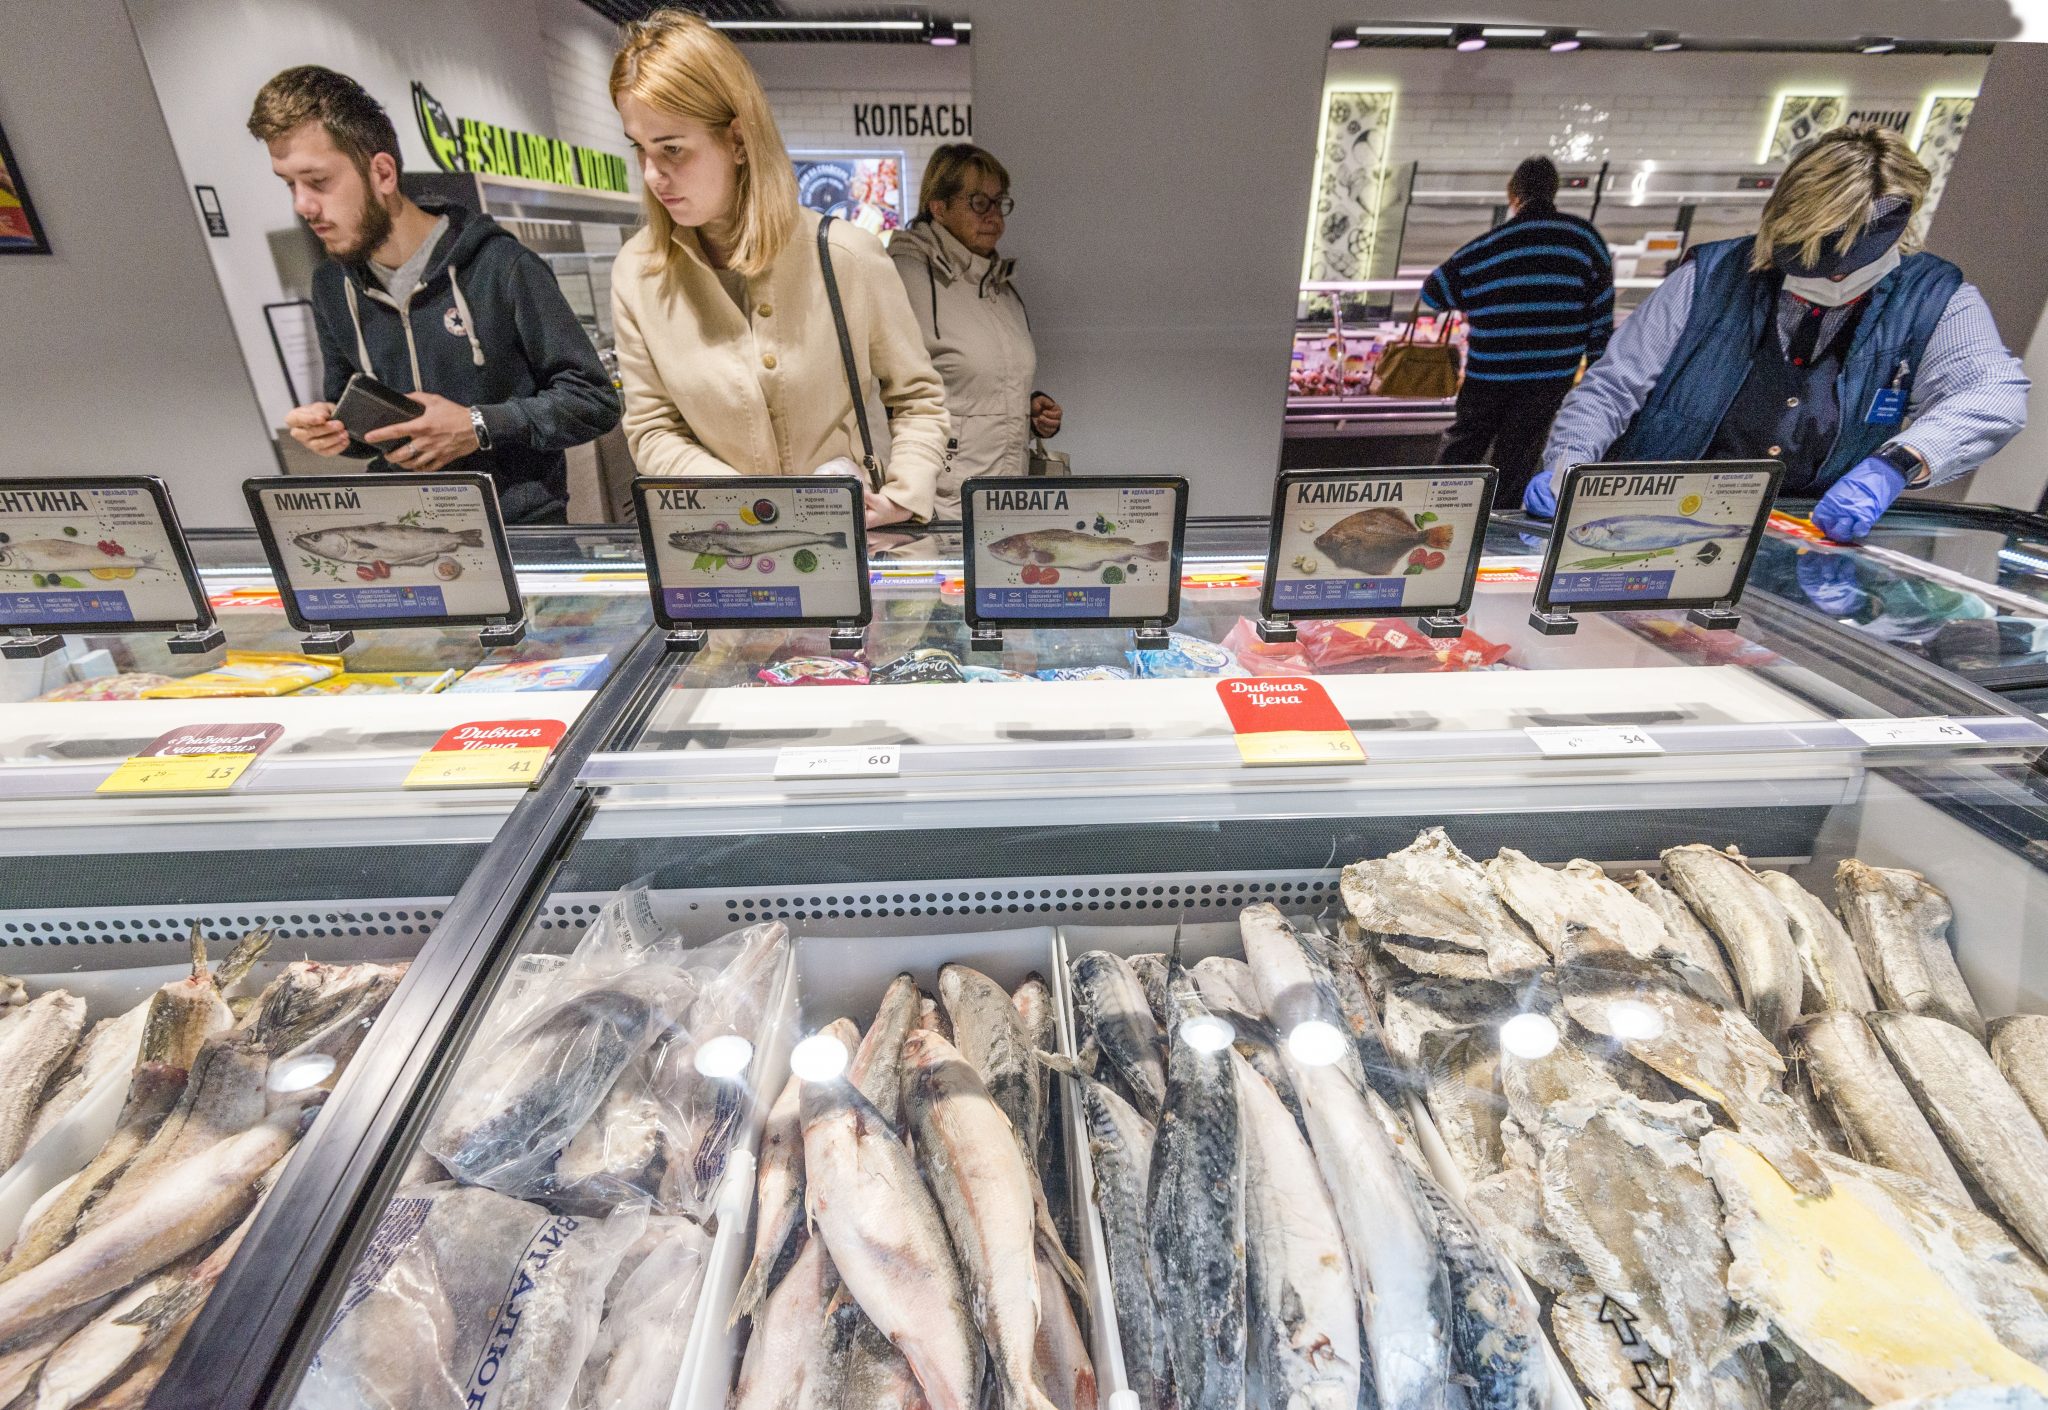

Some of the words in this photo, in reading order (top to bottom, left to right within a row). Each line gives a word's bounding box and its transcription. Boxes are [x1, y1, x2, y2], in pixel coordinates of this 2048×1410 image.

[854, 104, 972, 137] КОЛБАСЫ
[1579, 475, 1684, 496] МЕРЛАНГ
[1297, 482, 1403, 503] КАМБАЛА
[274, 488, 361, 511] МИНТАЙ
[986, 490, 1069, 511] НАВАГА
[1230, 682, 1308, 693] Дивная
[1247, 693, 1303, 707] Цена
[453, 726, 541, 740] Дивная
[1939, 726, 1963, 735] 45
[168, 735, 238, 746] «Рыбные
[1619, 734, 1645, 744] 34
[173, 743, 256, 754] четверги»
[1328, 741, 1350, 751] 16
[868, 755, 891, 765] 60
[508, 761, 531, 772] 41
[206, 767, 234, 779] 13
